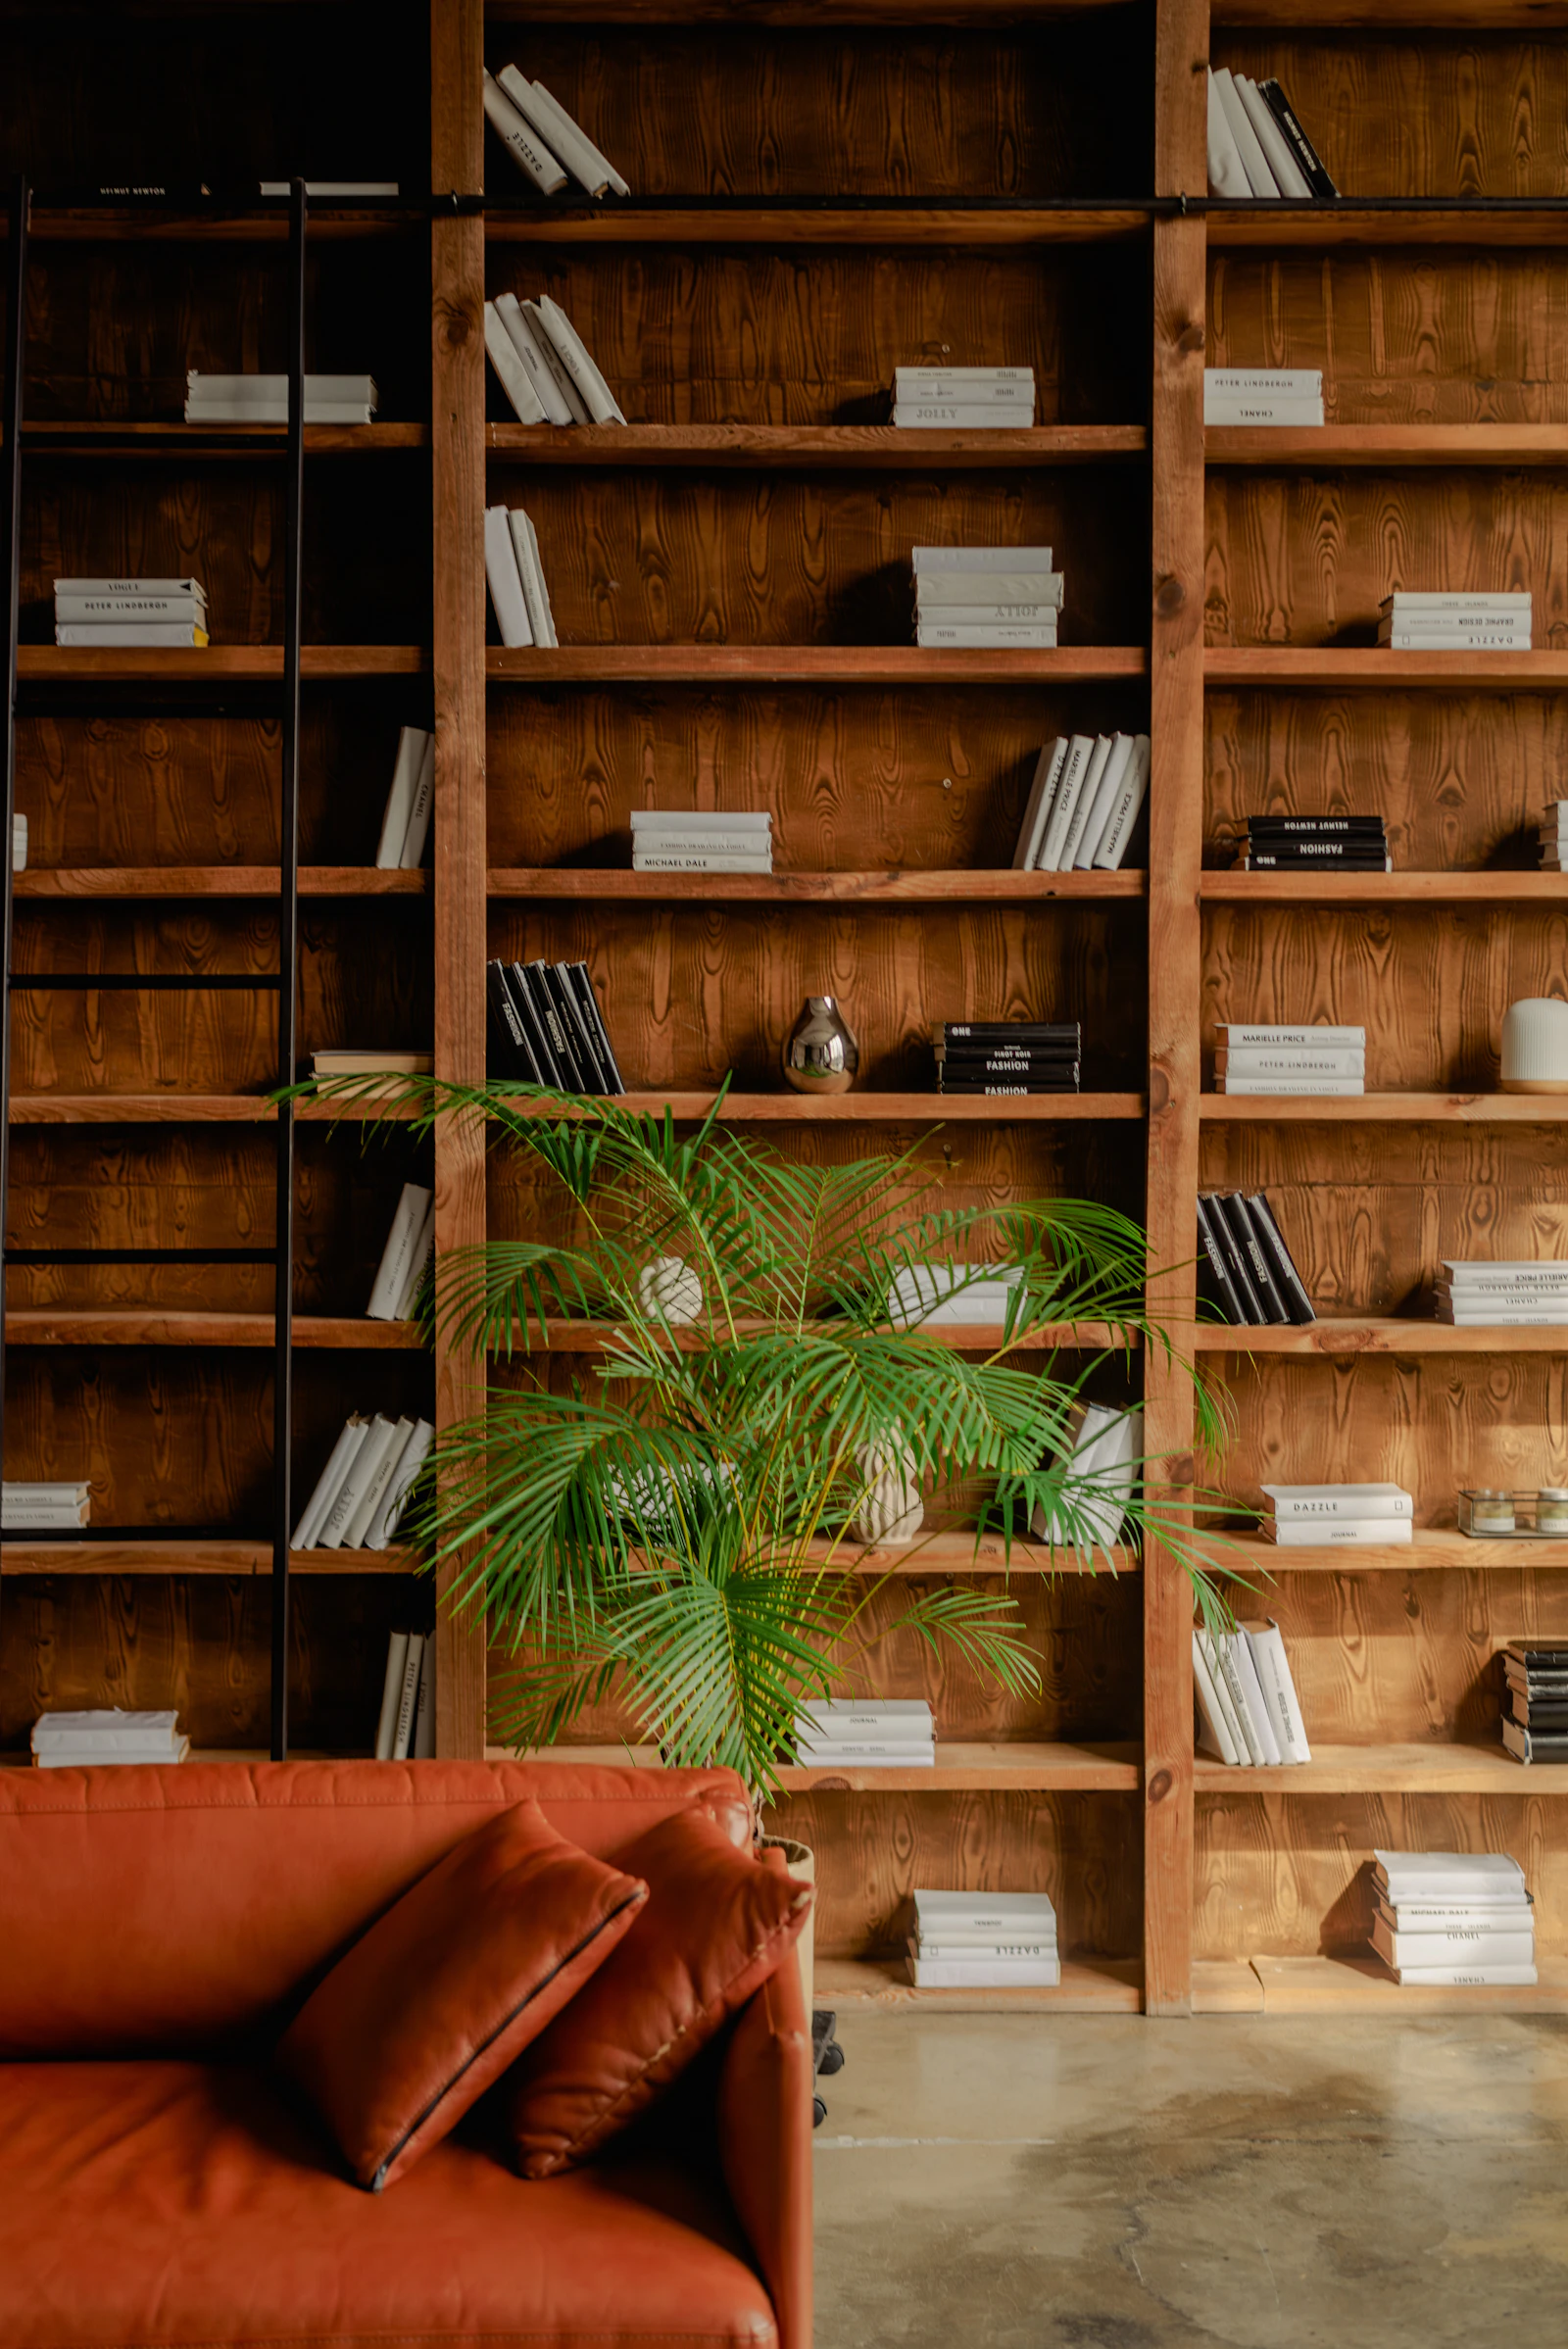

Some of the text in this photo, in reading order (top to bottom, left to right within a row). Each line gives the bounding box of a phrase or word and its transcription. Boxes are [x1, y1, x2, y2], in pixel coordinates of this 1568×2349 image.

[512, 131, 543, 172] DAZZLE
[916, 408, 957, 419] JOLLY
[995, 605, 1038, 617] JOLLY
[416, 784, 429, 819] CHANEL
[1107, 792, 1133, 855] MARIELLE PRICE
[1284, 821, 1348, 831] HELMUT NEWTON
[1299, 844, 1343, 855] FASHION
[645, 858, 682, 867] MICHAEL
[502, 1002, 523, 1047] FASHION
[545, 1009, 565, 1054] FASHION
[952, 1027, 972, 1037] ONE
[986, 1060, 1029, 1070] FASHION
[985, 1086, 1028, 1096] FASHION
[1203, 1237, 1225, 1280] FASHION
[1247, 1240, 1268, 1284] FASHION
[1270, 1237, 1294, 1278] FASHION
[329, 1487, 355, 1531] JOLLY
[1294, 1502, 1339, 1511] DAZZLE
[406, 1661, 416, 1689] PETER
[996, 1946, 1041, 1955] DAZZLE
